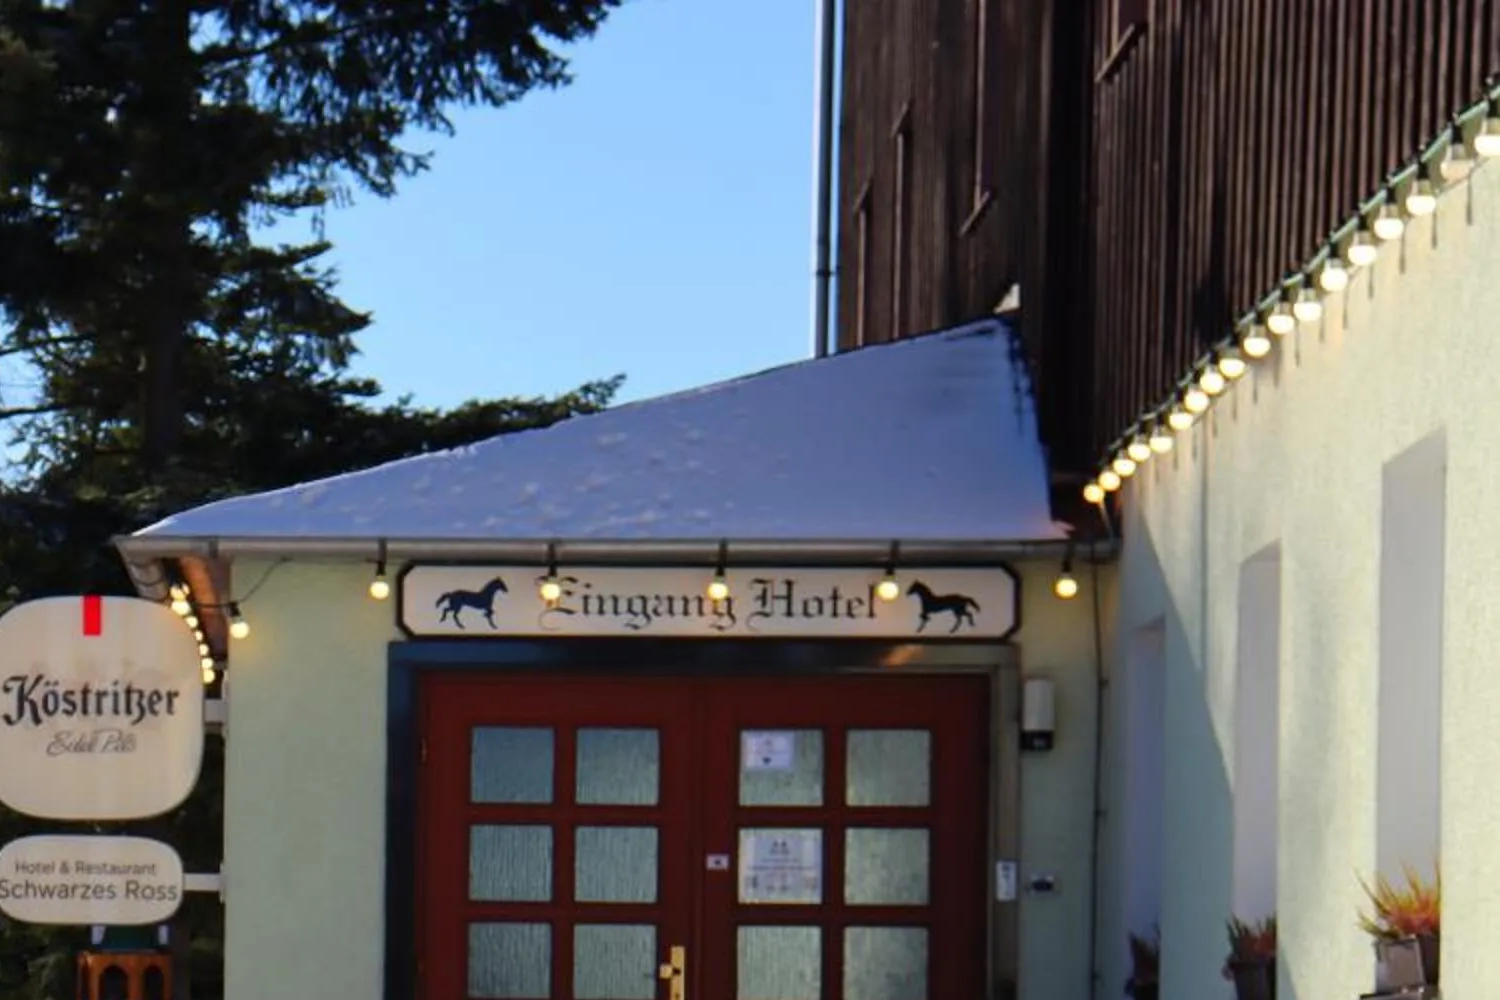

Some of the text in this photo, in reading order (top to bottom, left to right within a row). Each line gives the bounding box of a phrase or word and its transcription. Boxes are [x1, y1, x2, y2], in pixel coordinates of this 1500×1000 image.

[746, 577, 878, 632] Hotel
[2, 674, 180, 727] Köstritzer
[14, 860, 158, 876] Hotel & Restaurant
[124, 879, 178, 902] Ross
